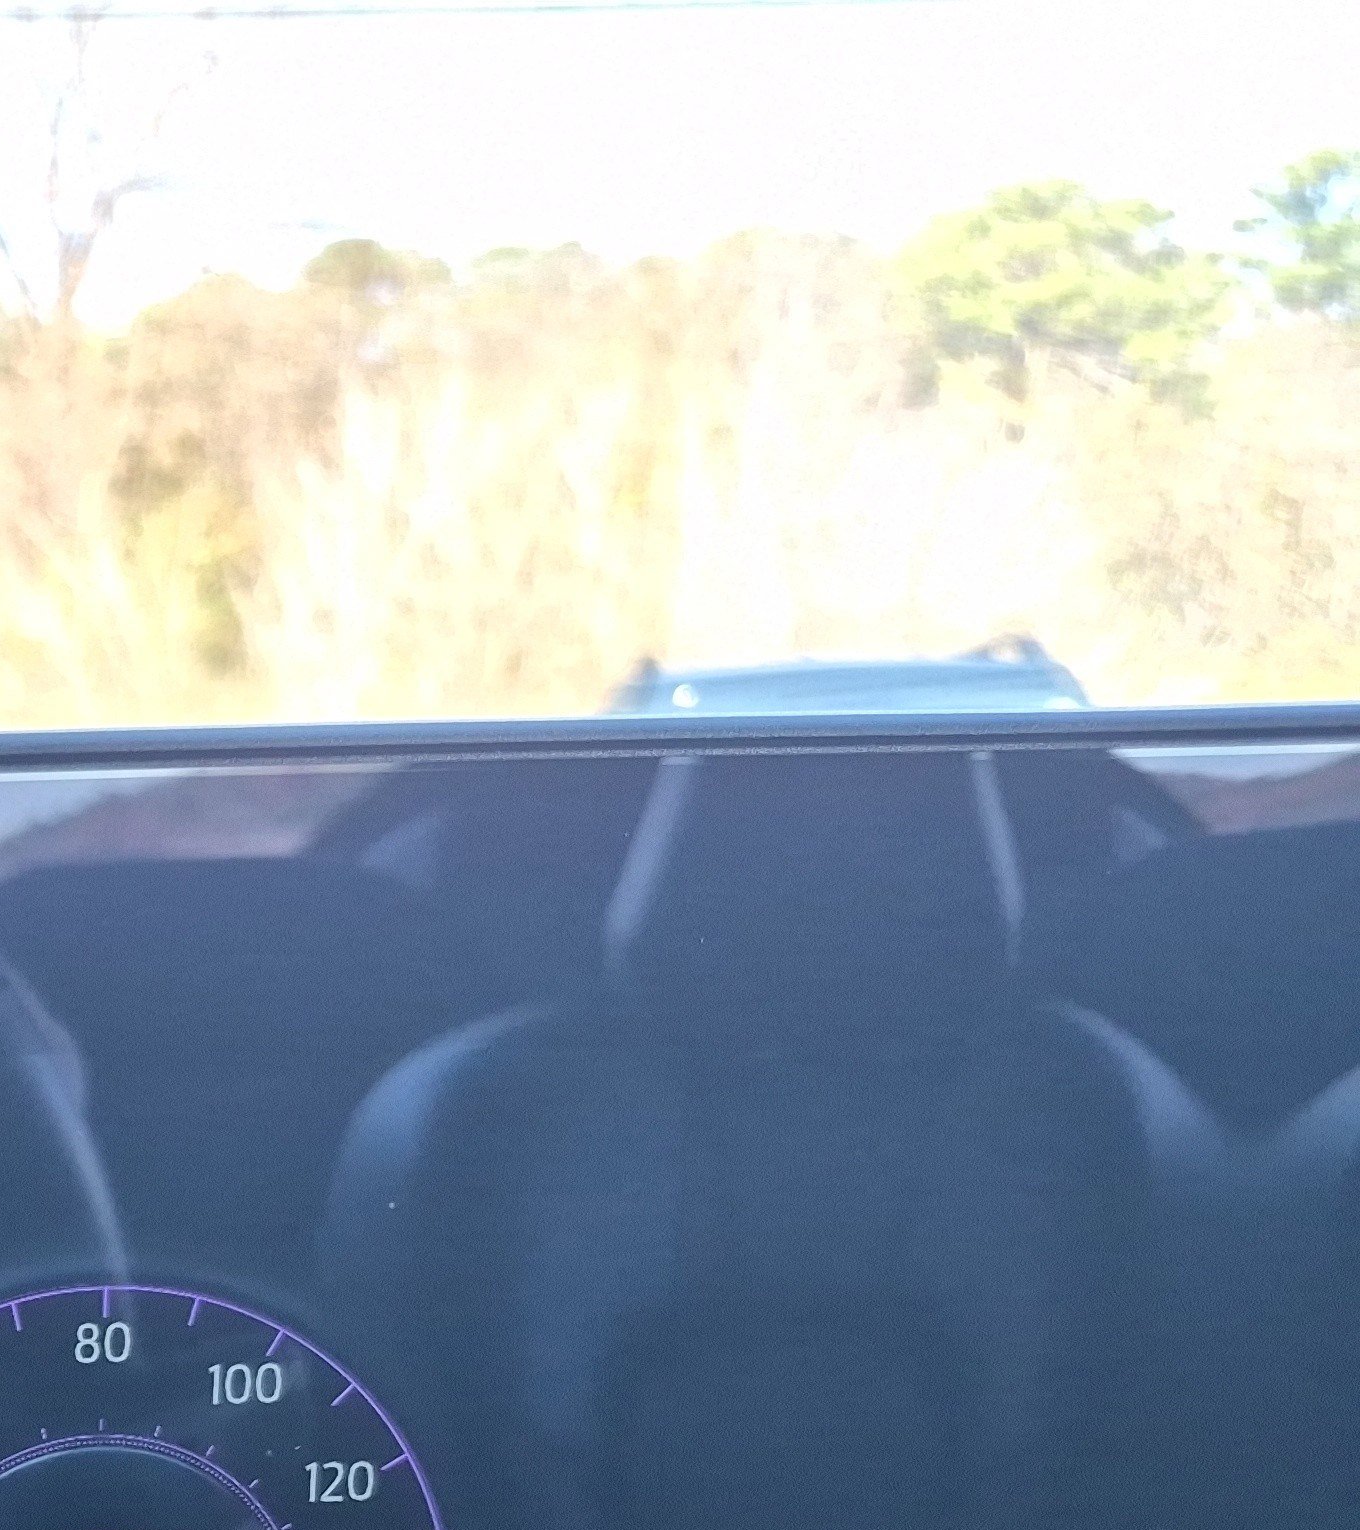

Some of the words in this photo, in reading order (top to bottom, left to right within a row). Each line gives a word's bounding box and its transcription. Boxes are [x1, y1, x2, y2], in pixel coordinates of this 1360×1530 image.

[74, 1321, 132, 1364] 80
[208, 1362, 283, 1405] 100
[305, 1460, 375, 1503] 120
